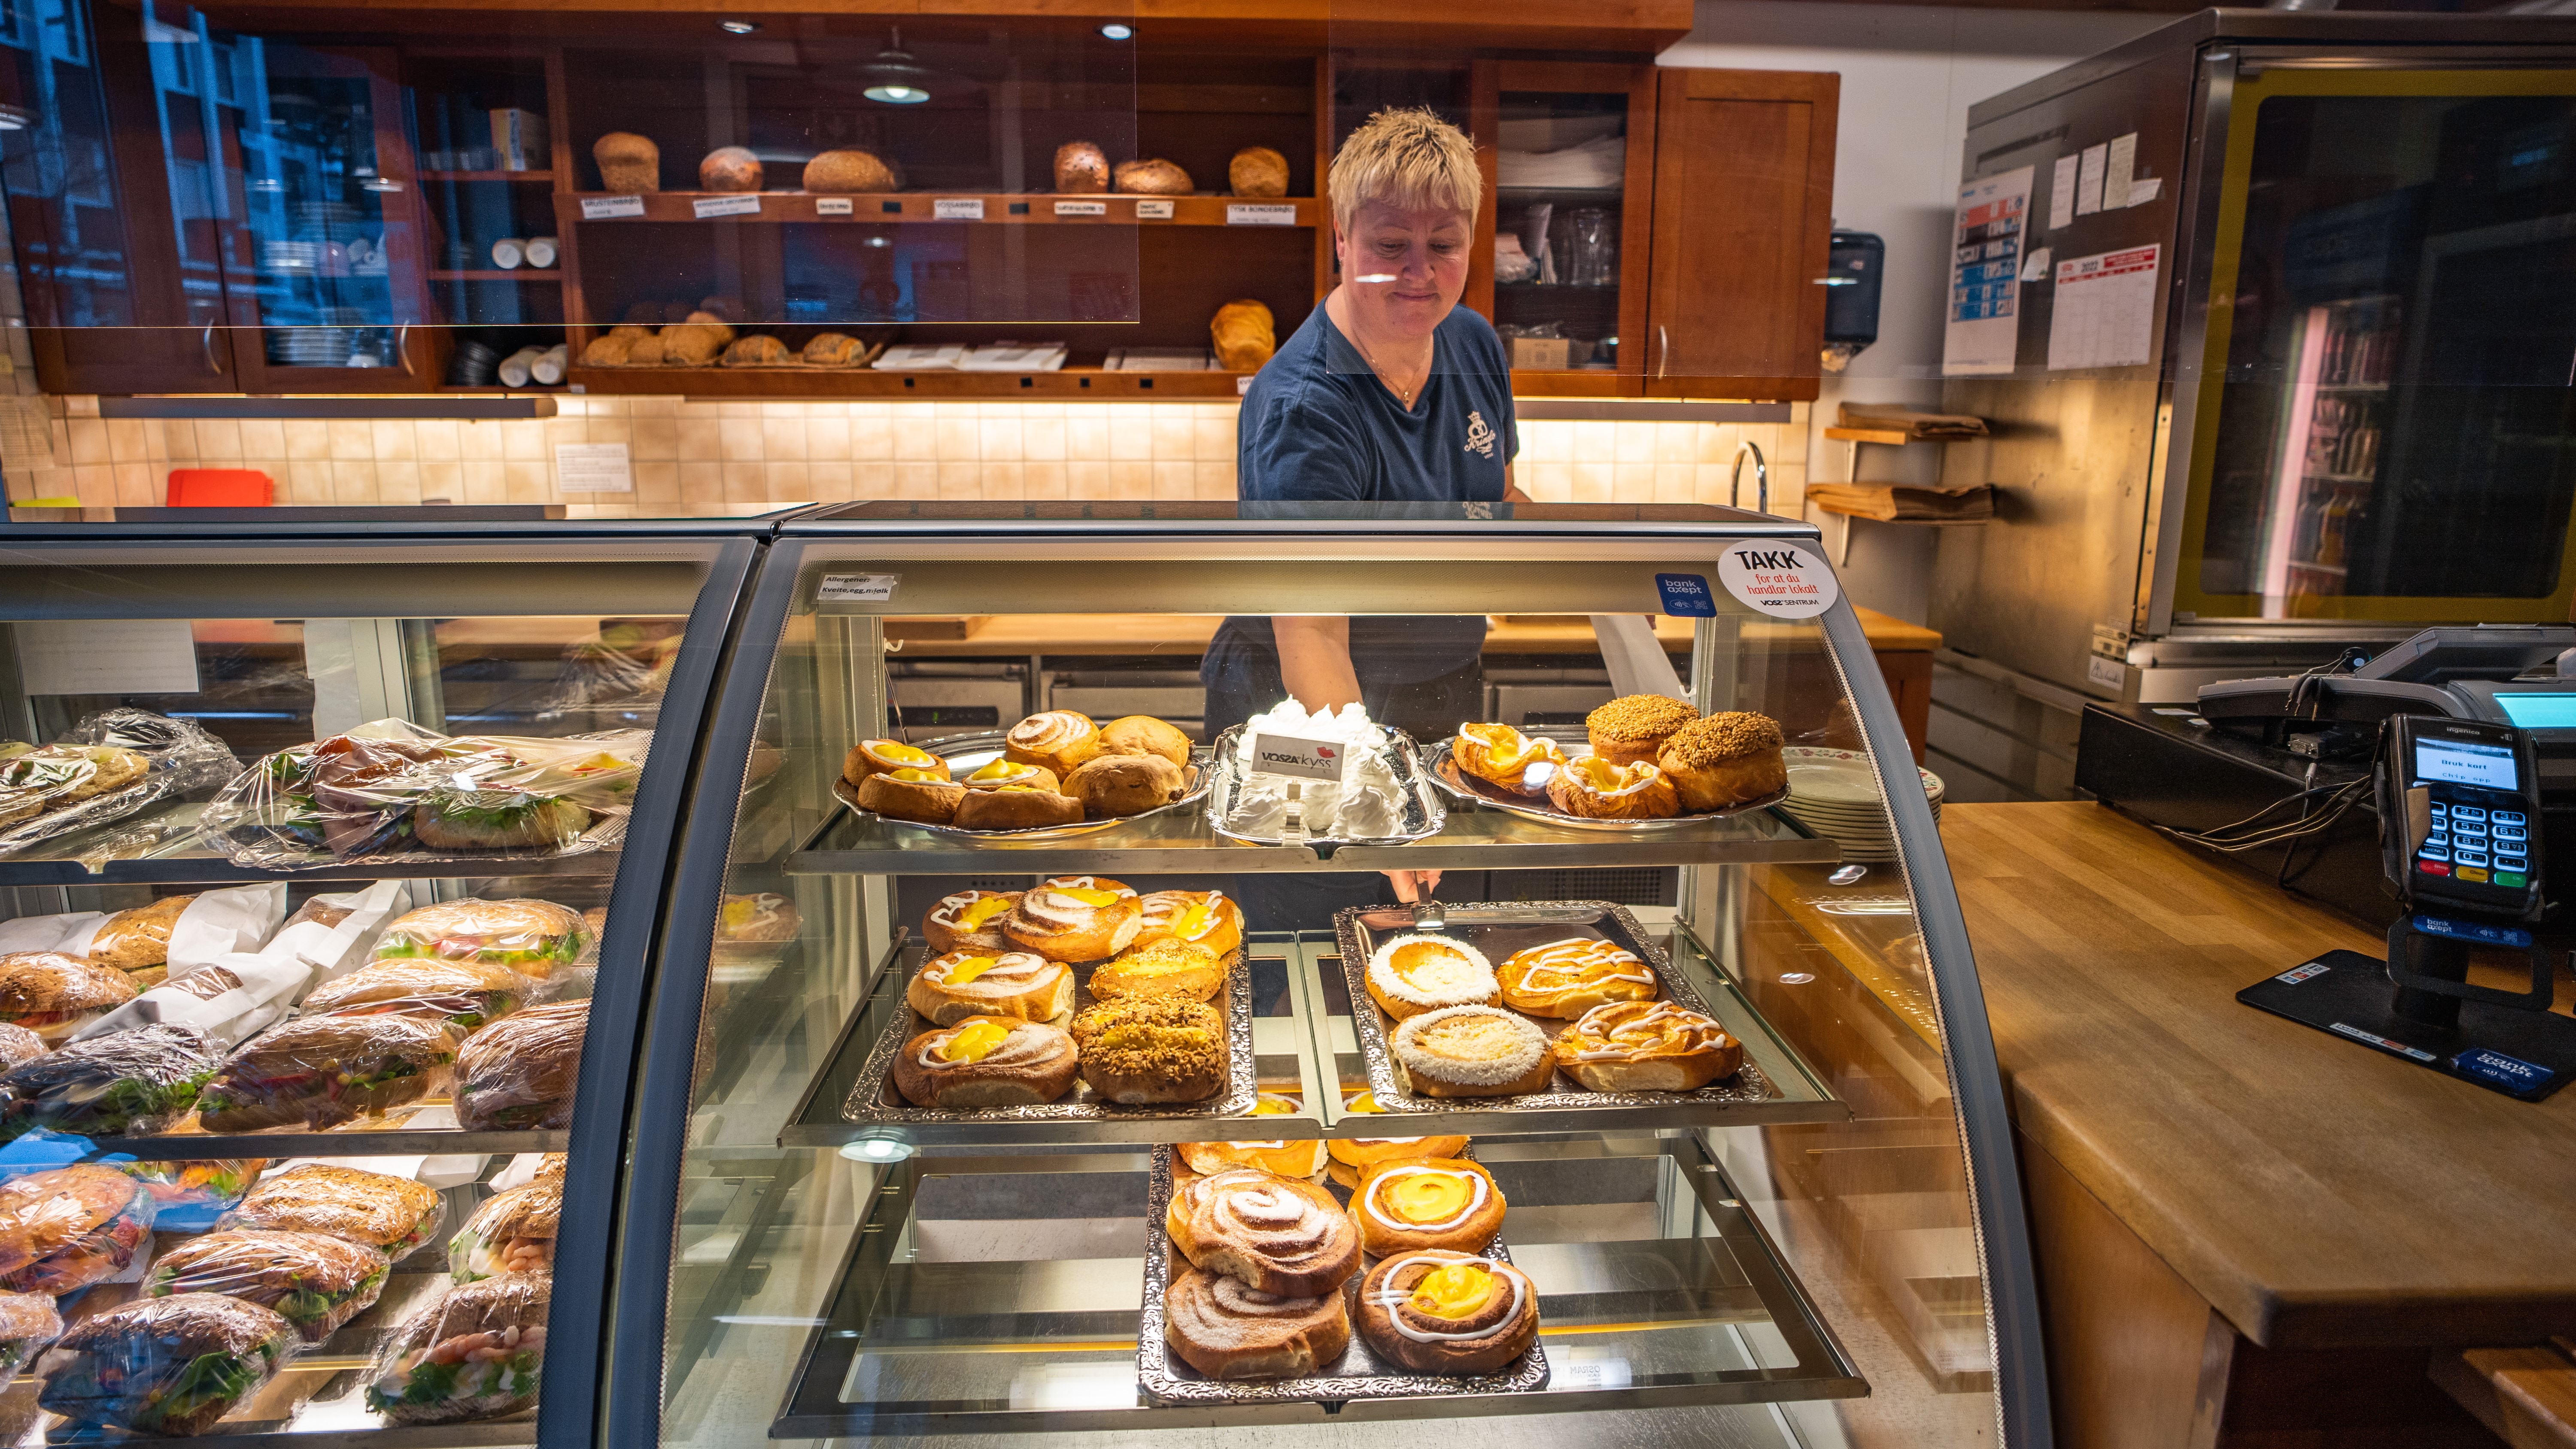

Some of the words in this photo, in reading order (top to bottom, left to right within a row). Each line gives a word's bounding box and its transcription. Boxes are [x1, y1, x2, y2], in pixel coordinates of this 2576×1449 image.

[1734, 550, 1804, 570] TAKK
[1665, 580, 1696, 588] bank
[1755, 574, 1771, 584] for
[1774, 574, 1784, 583] at
[1786, 574, 1800, 583] du
[1668, 585, 1702, 595] axept
[1747, 585, 1787, 594] handlar
[1790, 584, 1819, 594] lokalt
[2447, 727, 2480, 735] ingenico
[2427, 918, 2448, 927] bank
[2427, 924, 2452, 933] axept
[2477, 1057, 2533, 1078] axept
[2482, 1054, 2530, 1072] bank
